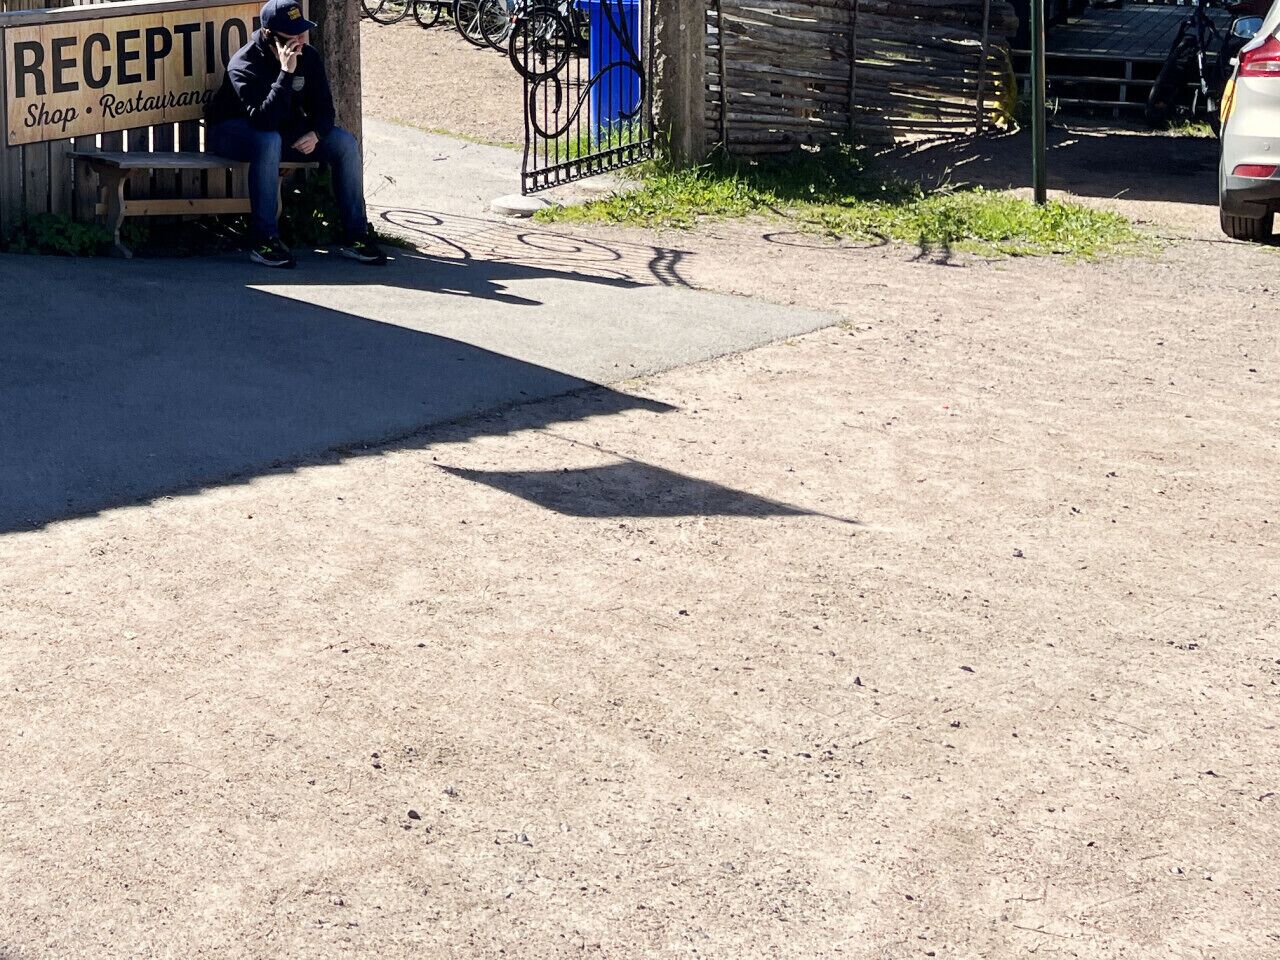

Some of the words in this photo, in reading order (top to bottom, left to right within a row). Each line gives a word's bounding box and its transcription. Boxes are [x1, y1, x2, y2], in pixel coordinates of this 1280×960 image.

[13, 16, 261, 99] RECEPTIO
[24, 102, 79, 132] Shop
[99, 89, 215, 119] Restaurang
